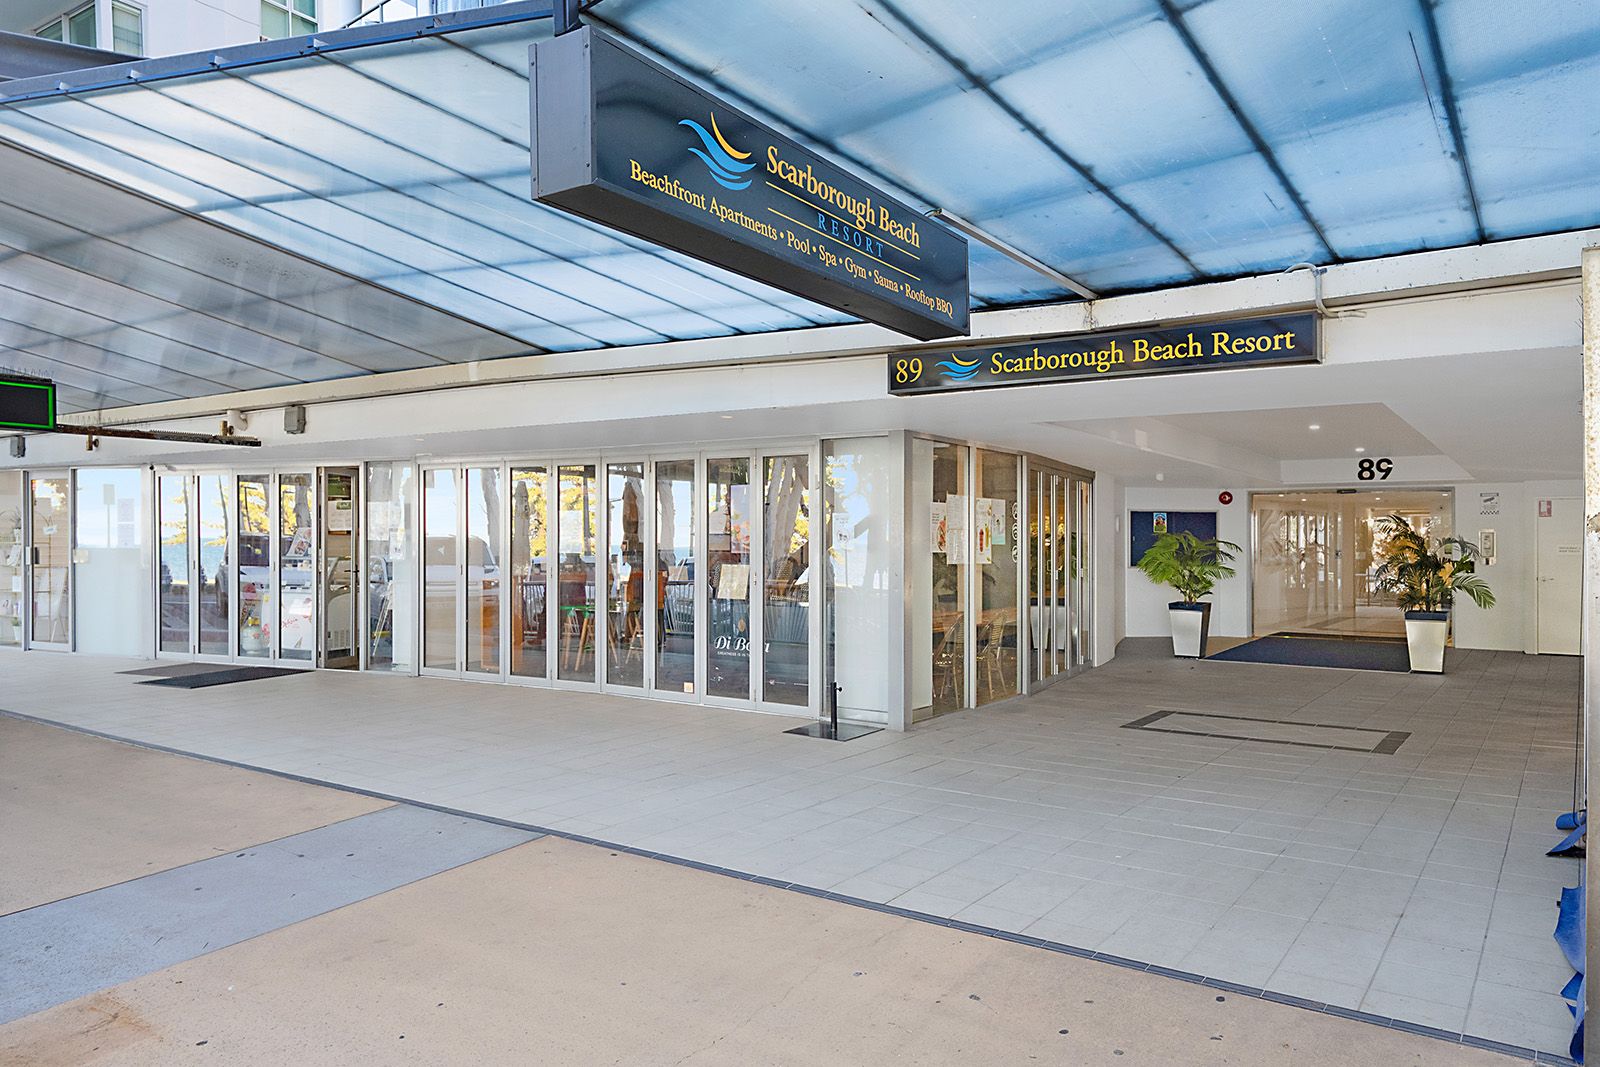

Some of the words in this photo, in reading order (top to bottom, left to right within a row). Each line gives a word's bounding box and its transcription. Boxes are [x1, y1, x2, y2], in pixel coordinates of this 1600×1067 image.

[766, 145, 876, 231] Scarborough
[879, 206, 920, 249] Beach
[630, 159, 707, 211] Beachfront
[709, 197, 778, 242] Apartments
[787, 230, 811, 256] Pool
[818, 244, 838, 267] Spa
[844, 256, 867, 281] Gym
[873, 269, 899, 293] Sauna
[905, 283, 936, 313] Rooftop
[935, 297, 954, 319] BBQ
[817, 212, 885, 258] RESORT
[896, 357, 923, 384] 89
[990, 340, 1125, 374] Scarborough
[1132, 333, 1204, 363] Beach
[1211, 330, 1296, 356] Resort
[1357, 457, 1394, 481] 89
